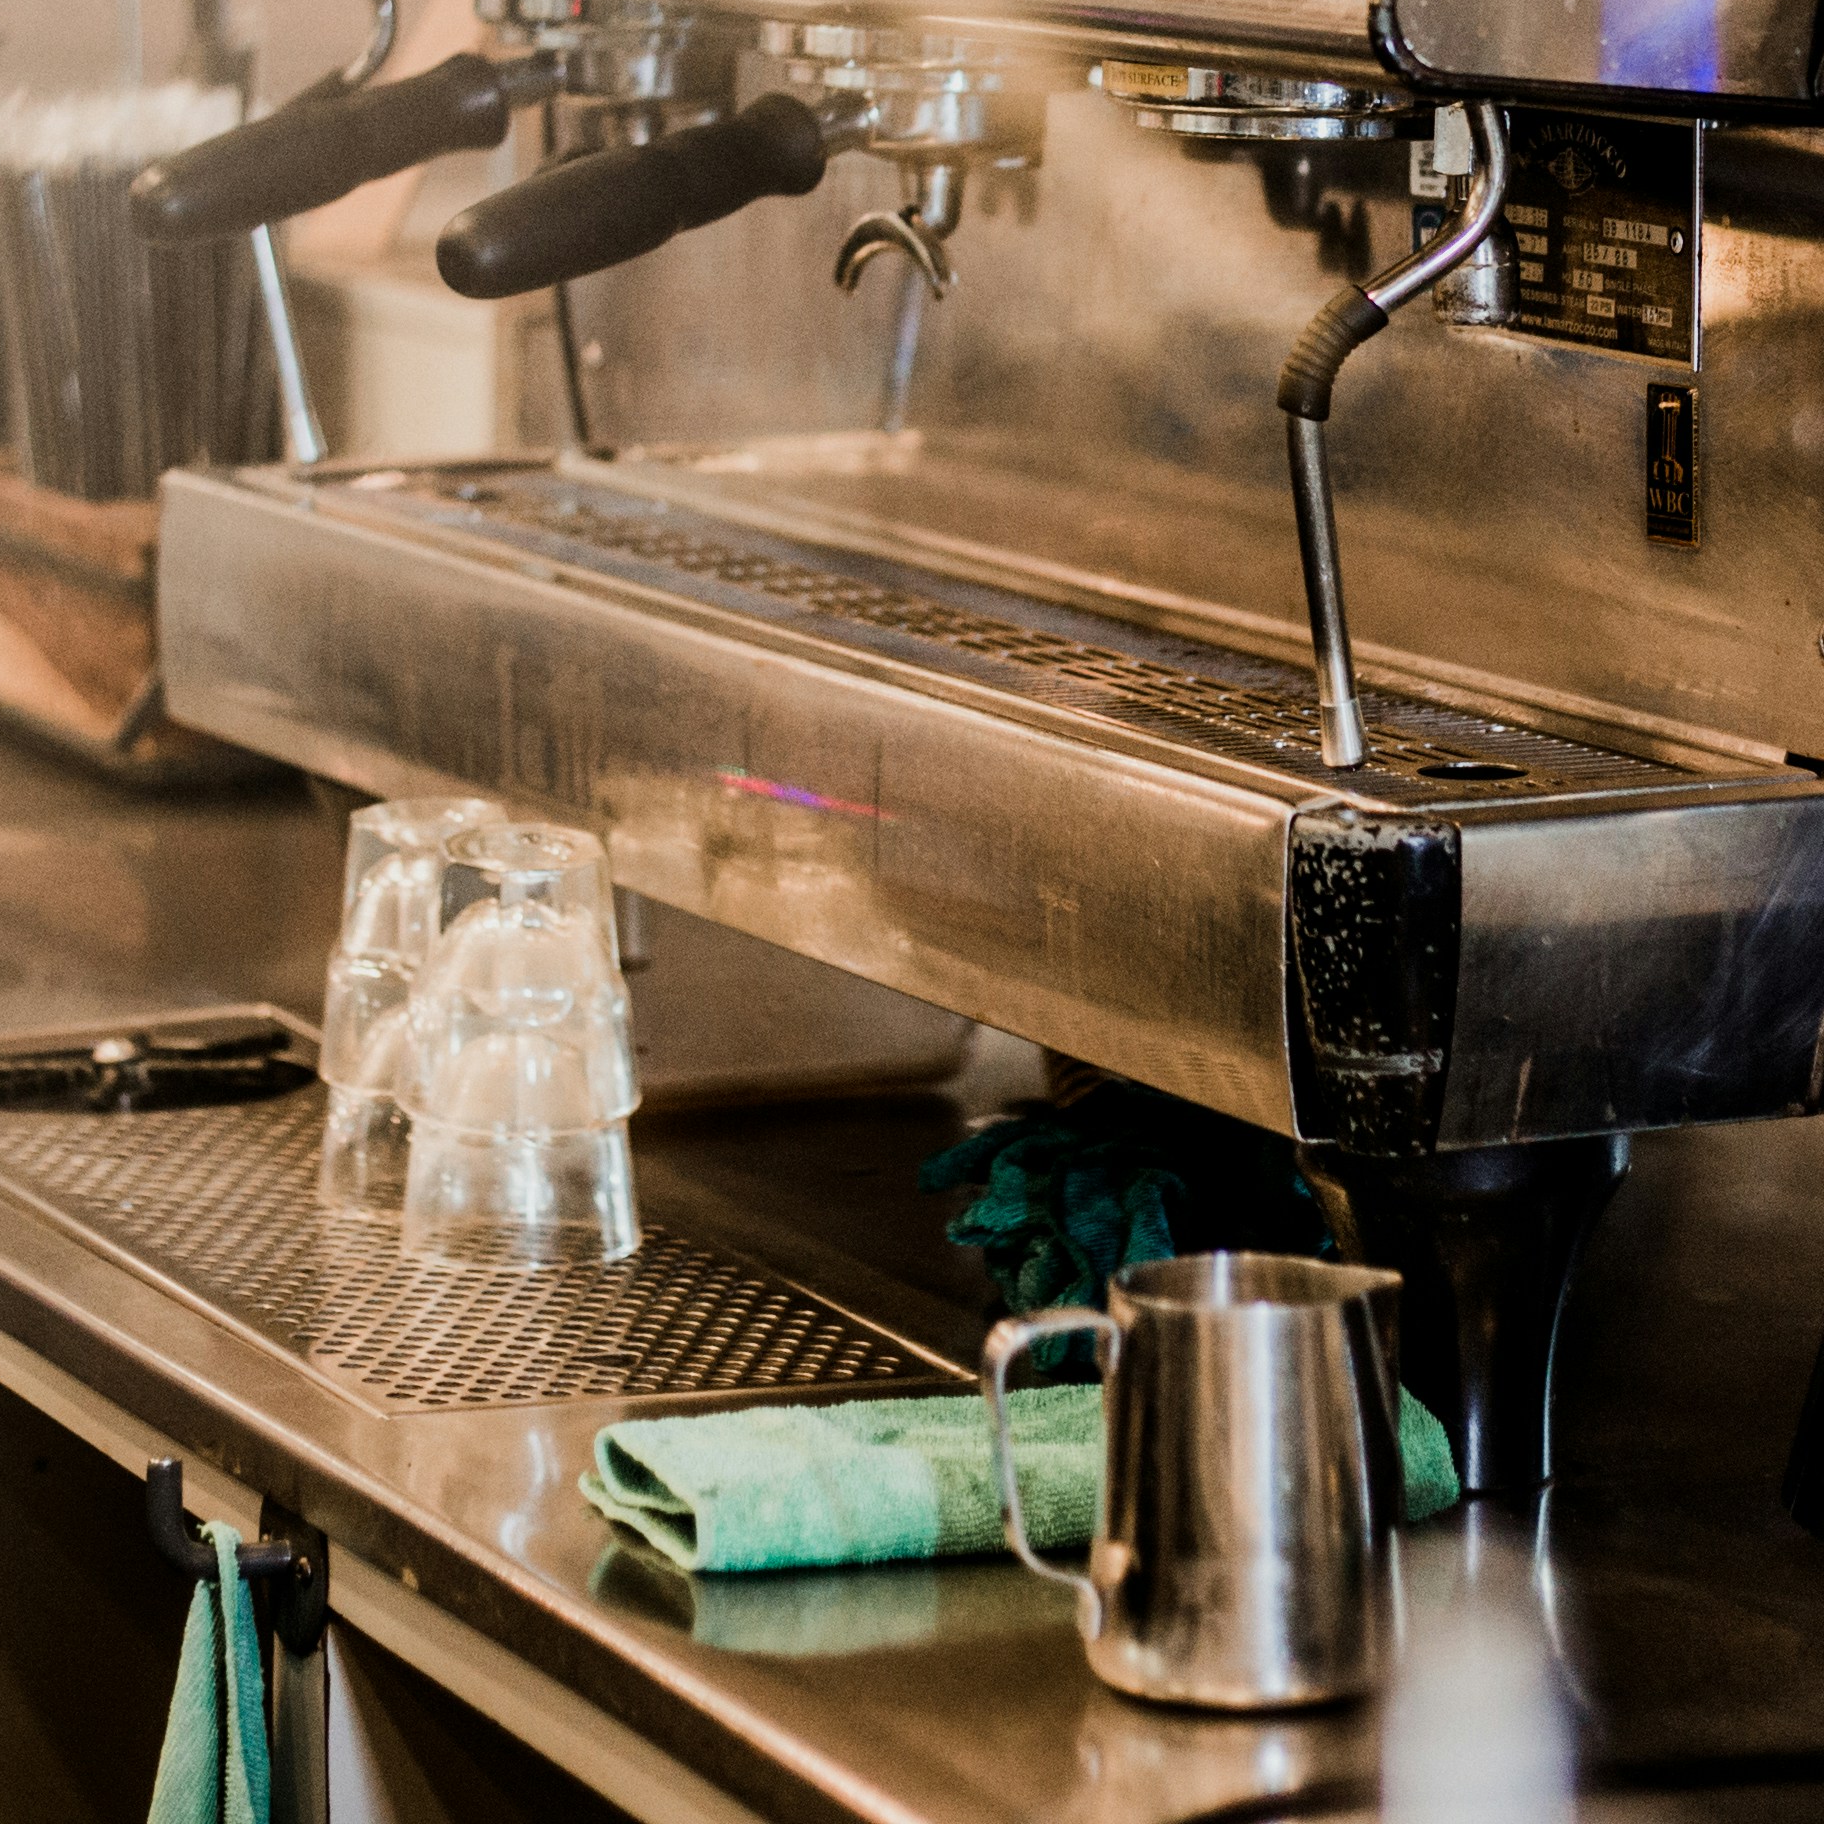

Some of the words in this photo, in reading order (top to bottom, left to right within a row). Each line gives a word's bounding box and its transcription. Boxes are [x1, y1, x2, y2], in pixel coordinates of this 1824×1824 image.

[1539, 121, 1627, 179] MARZOCCO
[1521, 313, 1619, 340] www.lamarzocco.com
[1649, 487, 1691, 516] WBC
